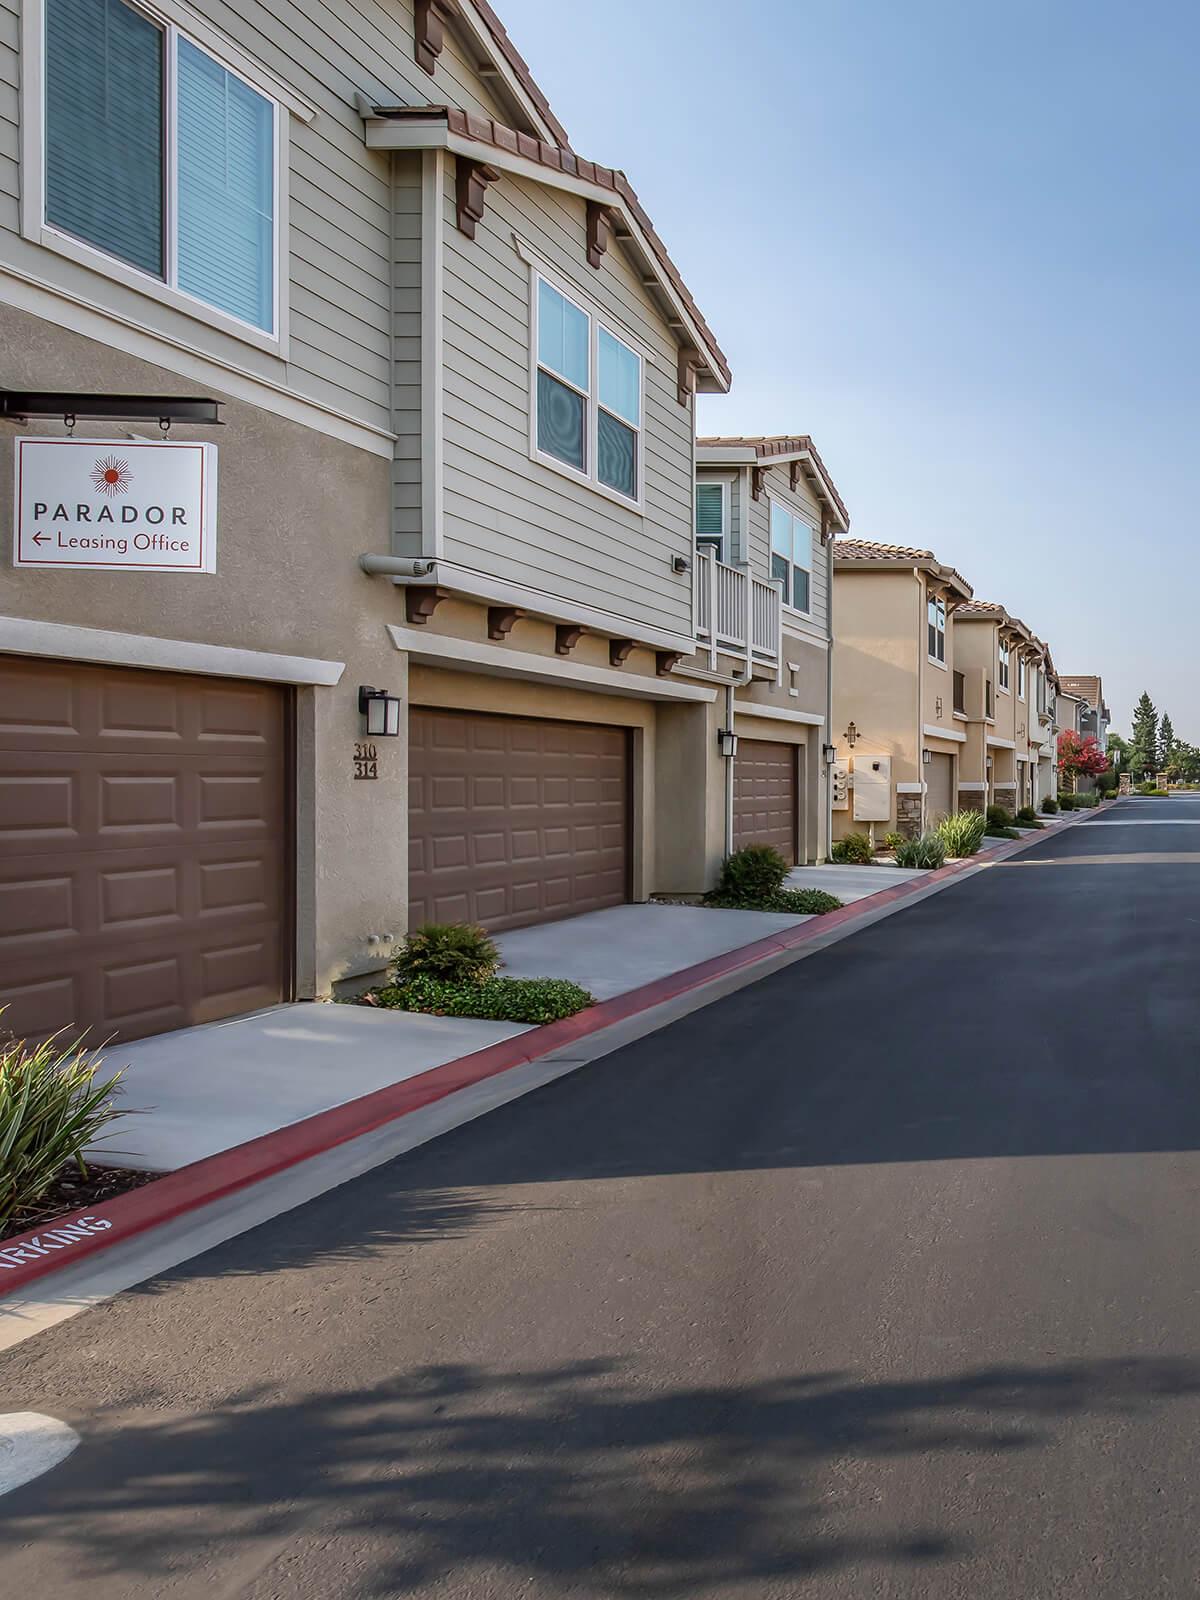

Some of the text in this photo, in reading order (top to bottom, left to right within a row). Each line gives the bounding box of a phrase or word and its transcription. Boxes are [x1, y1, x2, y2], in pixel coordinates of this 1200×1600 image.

[34, 502, 187, 525] PARADOR
[58, 531, 190, 554] Leasing Office
[353, 743, 377, 760] 310
[354, 761, 378, 779] 314
